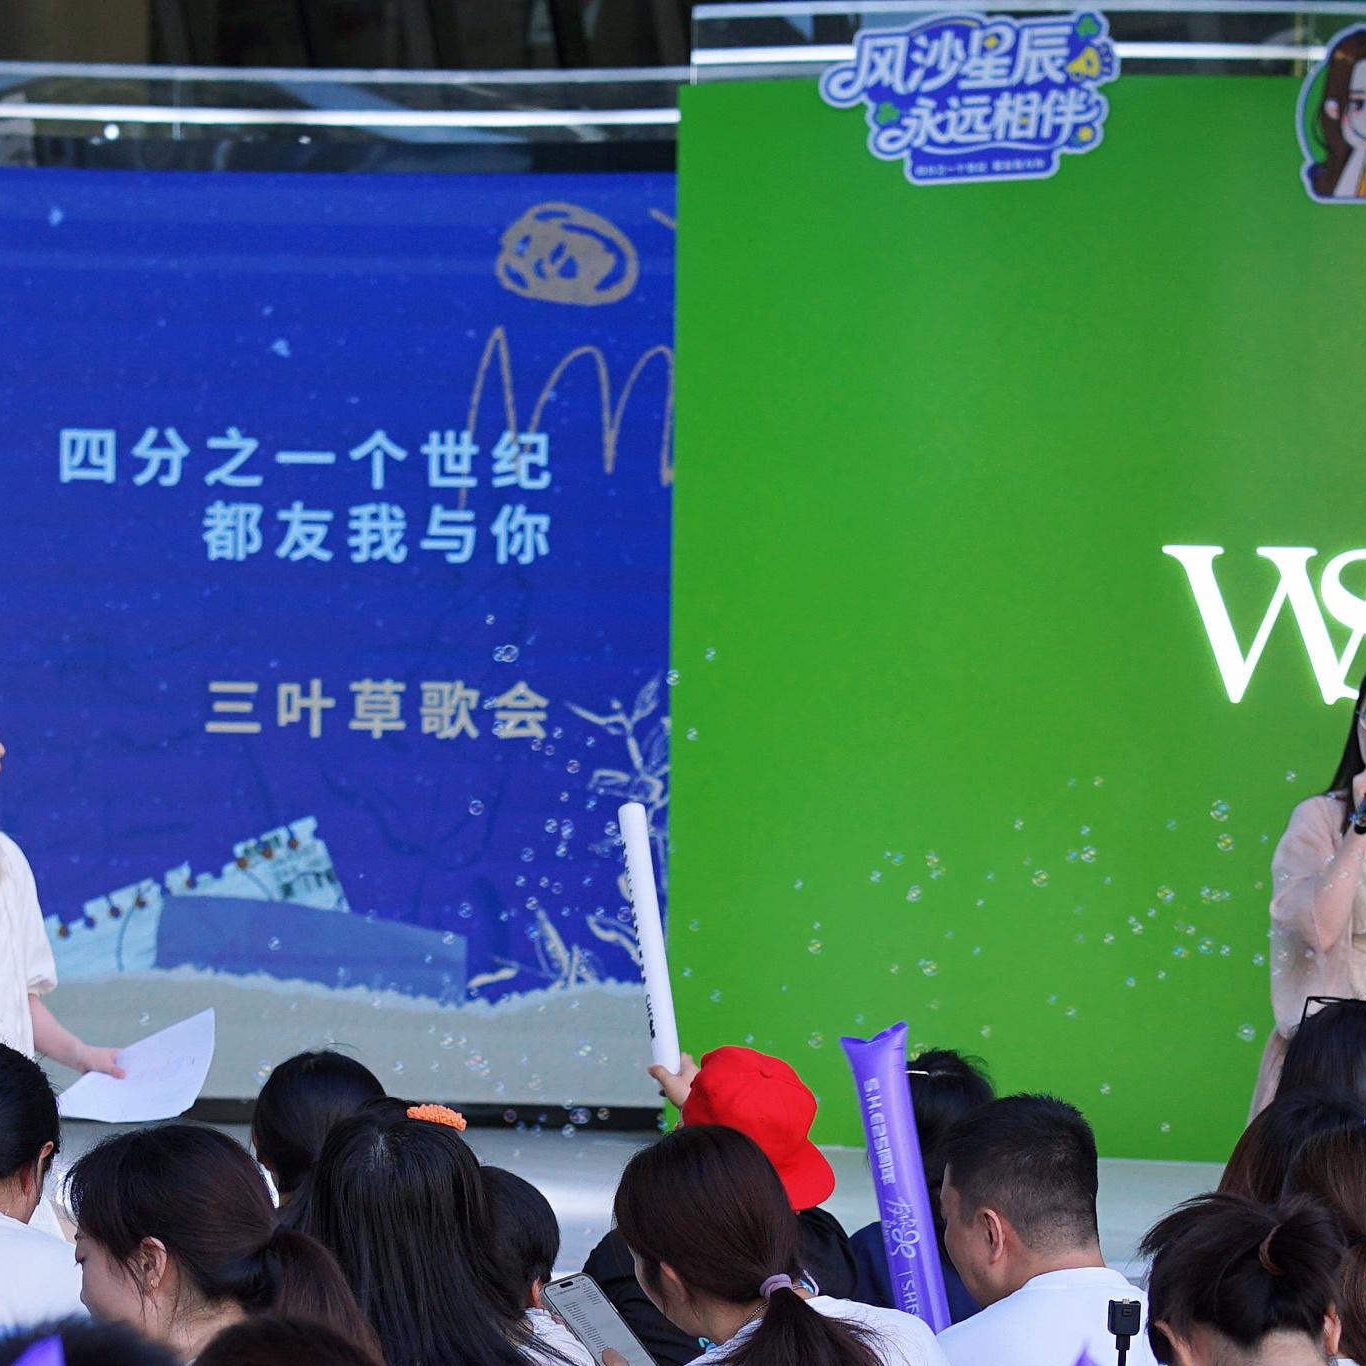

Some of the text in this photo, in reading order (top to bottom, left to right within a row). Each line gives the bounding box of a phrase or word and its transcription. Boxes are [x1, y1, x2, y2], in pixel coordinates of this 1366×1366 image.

[827, 23, 1073, 100] 风沙星辰
[875, 87, 1099, 151] 永远相伴
[59, 427, 552, 490] 四分之一个世纪
[203, 502, 550, 564] 都友我与你
[205, 680, 550, 740] 三叶草歌会
